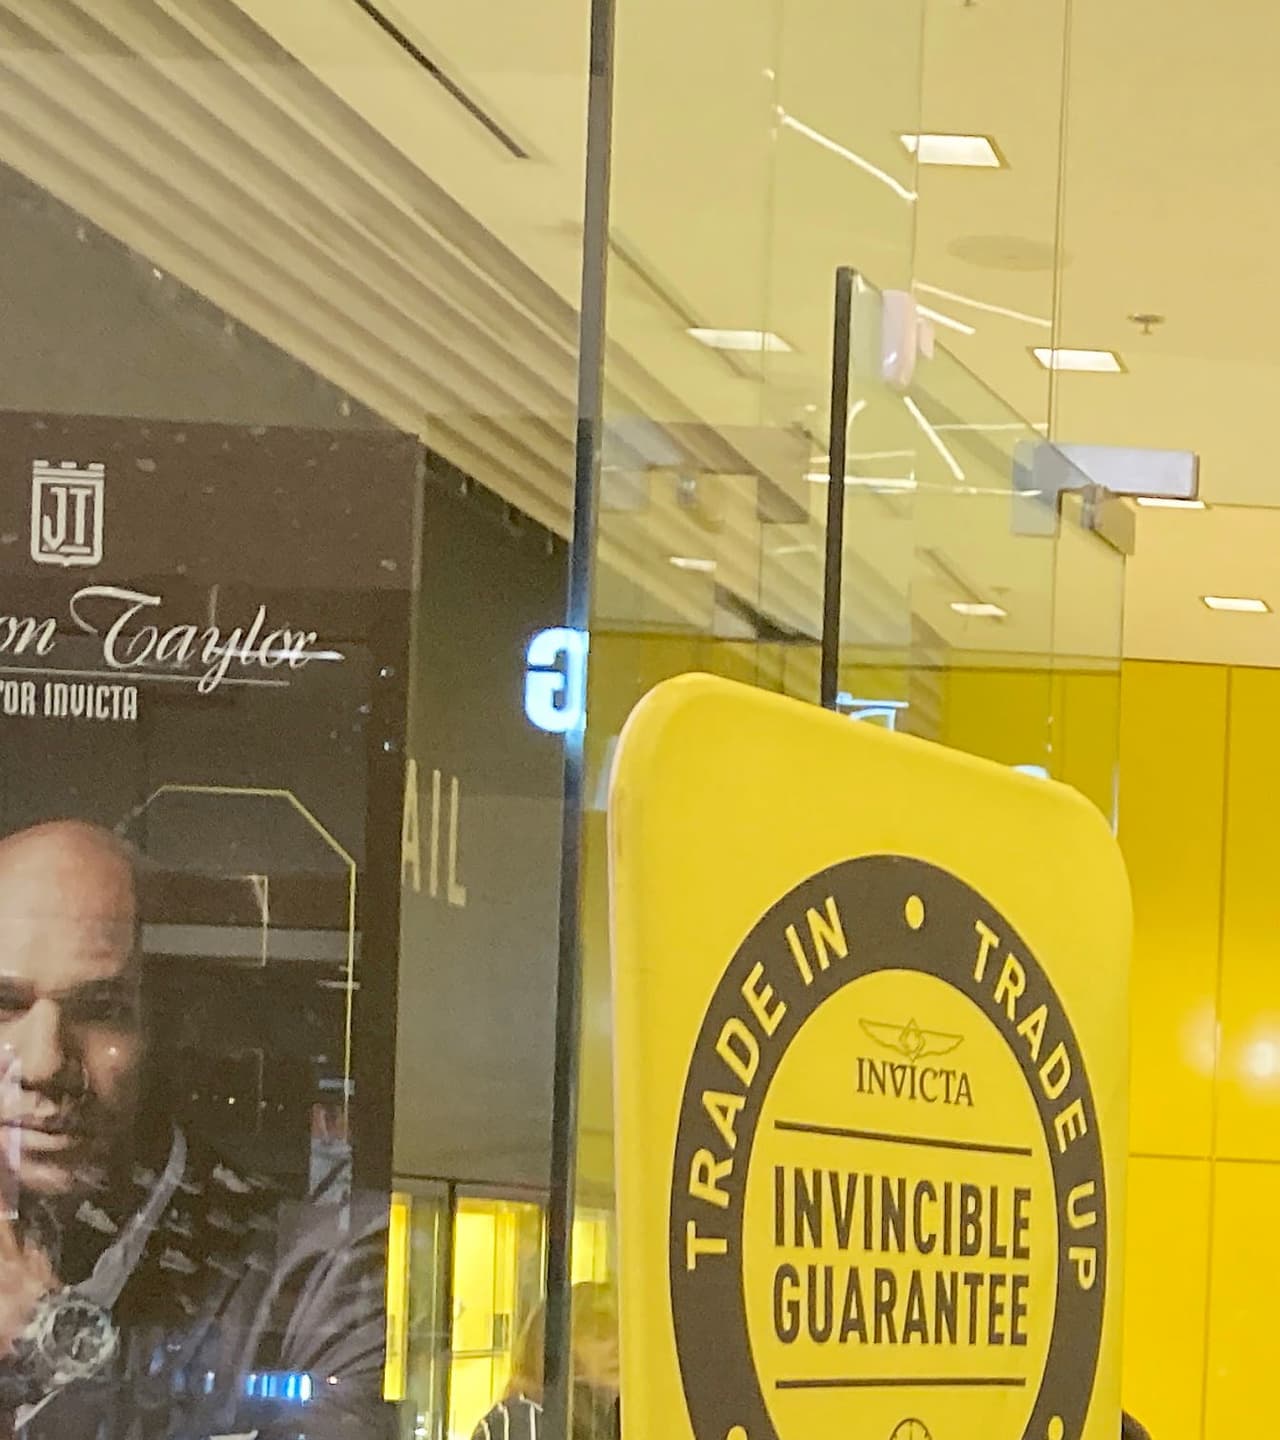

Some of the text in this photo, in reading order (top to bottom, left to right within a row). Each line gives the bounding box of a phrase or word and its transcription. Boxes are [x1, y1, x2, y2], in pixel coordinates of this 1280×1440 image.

[69, 585, 319, 694] Taylor
[44, 682, 137, 720] INVICTA
[686, 895, 849, 1271] TRADE IN
[855, 1056, 975, 1108] INVICTA
[973, 919, 1097, 1291] TRADE UP
[773, 1165, 1032, 1260] INVINCIBLE
[773, 1263, 1029, 1347] GUARANTEE
